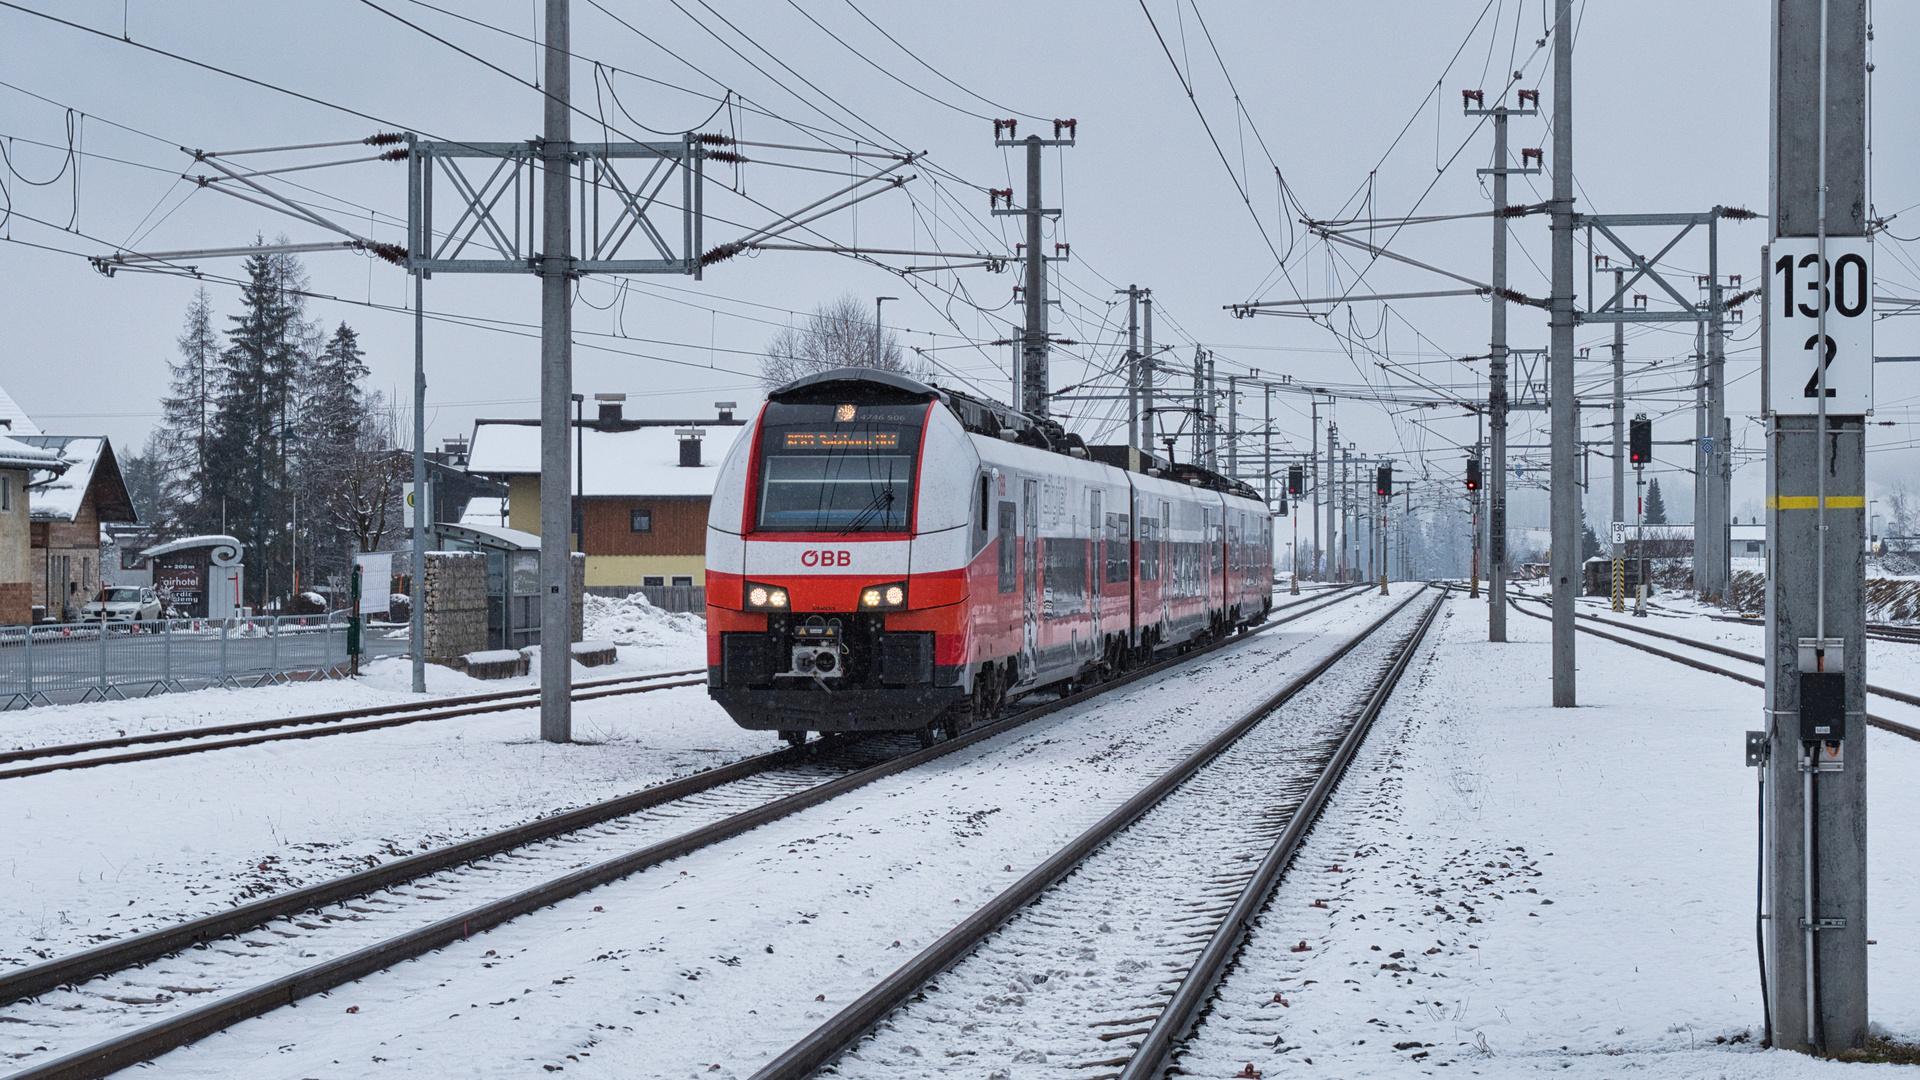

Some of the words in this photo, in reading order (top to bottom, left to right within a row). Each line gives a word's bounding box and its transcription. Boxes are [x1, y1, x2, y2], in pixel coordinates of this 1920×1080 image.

[1775, 253, 1867, 318] 130
[1804, 333, 1837, 398] 2
[1613, 523, 1624, 532] 130
[1616, 533, 1621, 542] 3
[801, 550, 851, 567] ÖBB
[161, 576, 199, 586] airhotel
